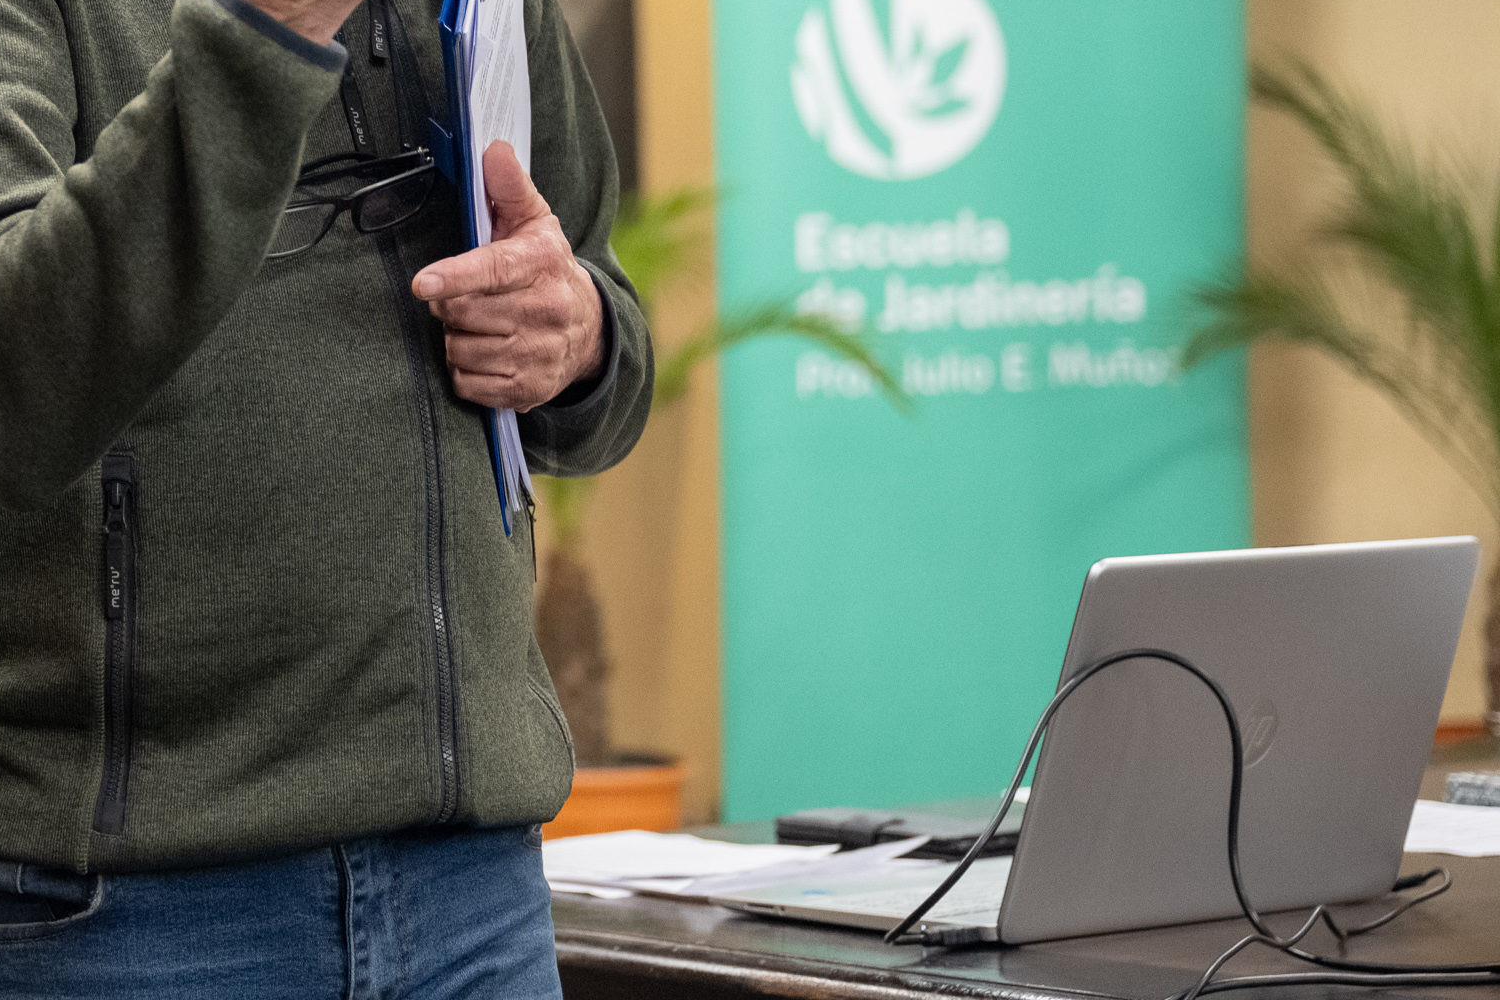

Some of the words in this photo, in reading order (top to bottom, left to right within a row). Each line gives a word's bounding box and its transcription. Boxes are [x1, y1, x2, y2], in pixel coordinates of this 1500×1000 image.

[797, 210, 1008, 271] Escuela
[798, 278, 866, 333] de
[880, 264, 1146, 331] Jardinería
